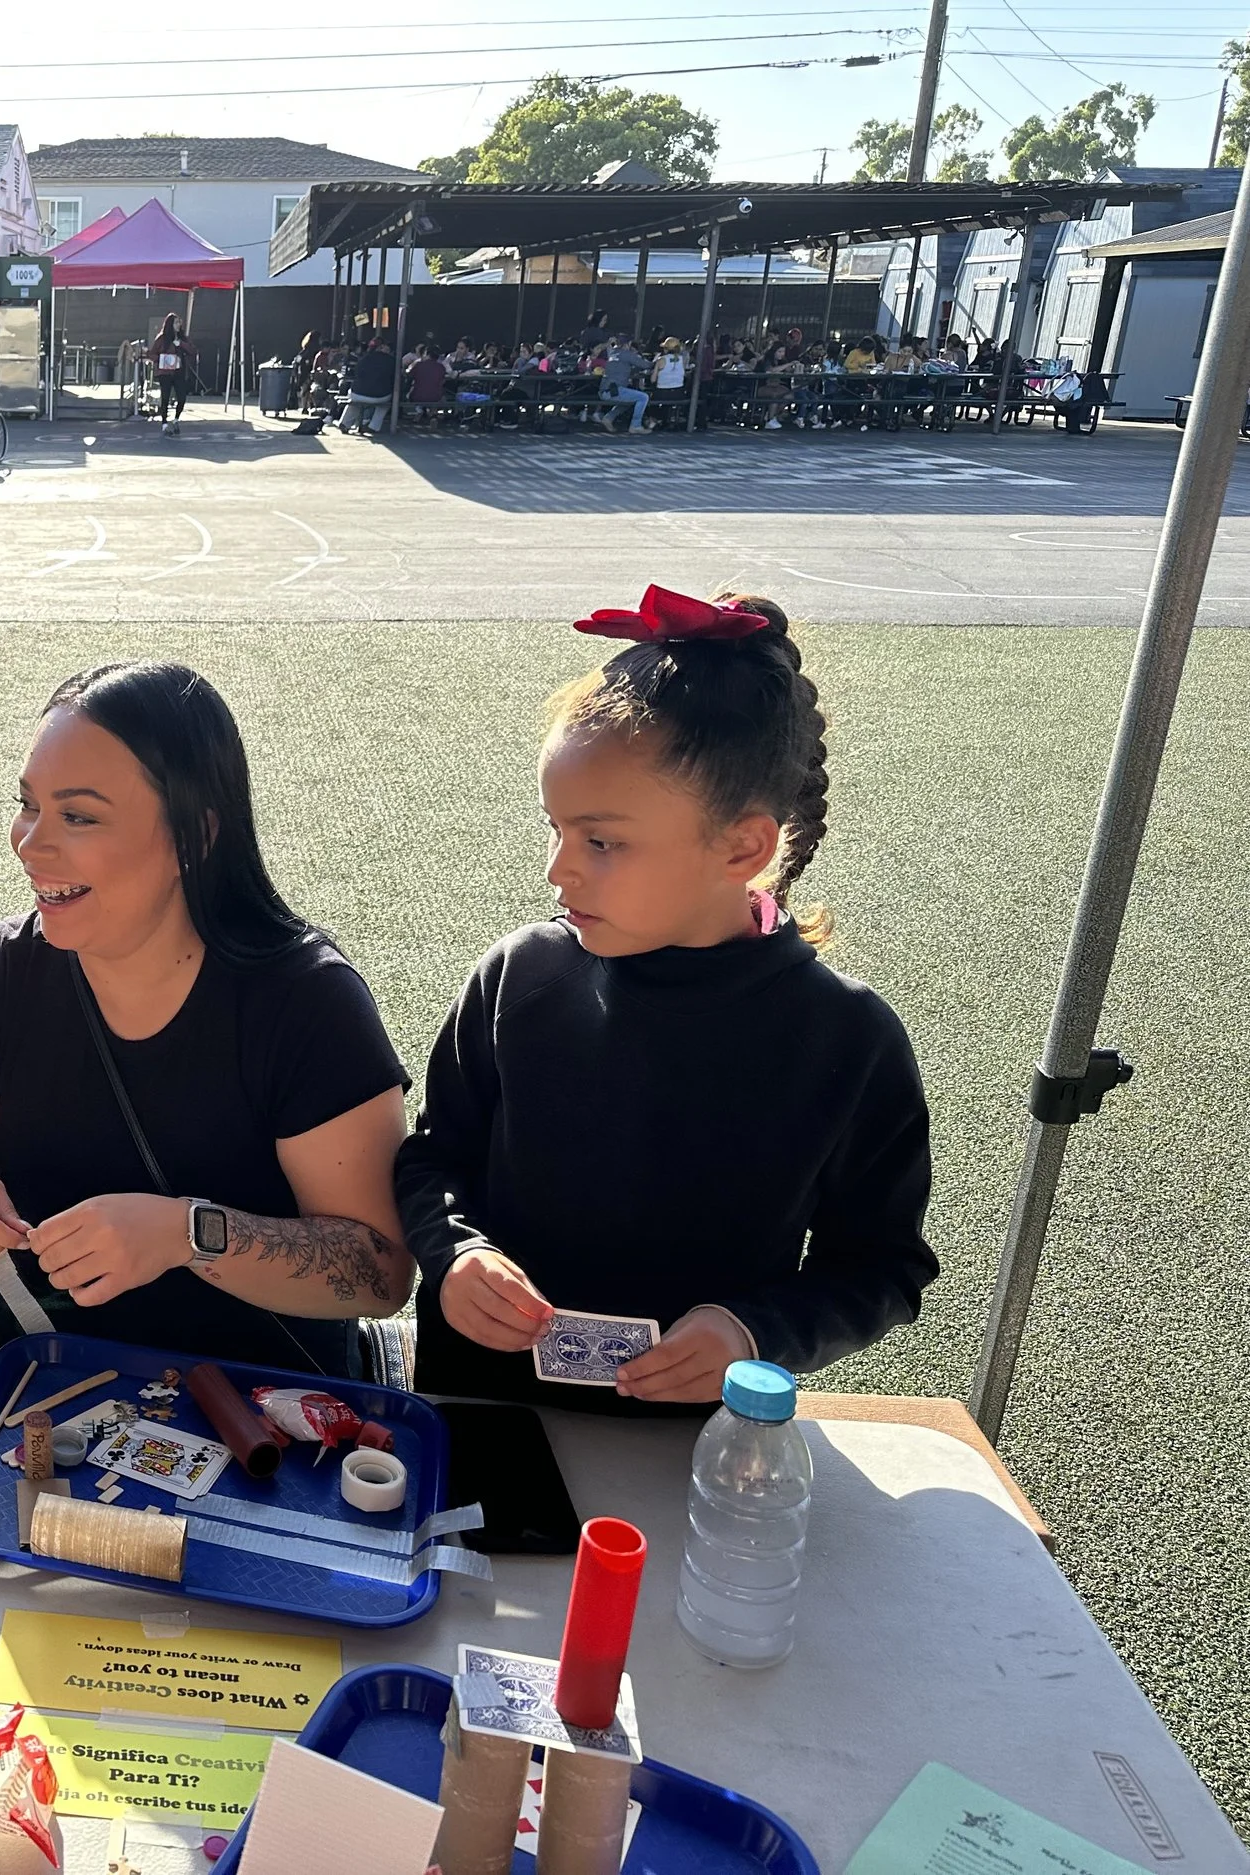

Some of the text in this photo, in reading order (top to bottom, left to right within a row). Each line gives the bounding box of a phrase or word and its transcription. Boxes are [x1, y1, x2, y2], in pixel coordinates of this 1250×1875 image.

[126, 1647, 162, 1657] ideas
[163, 1651, 198, 1660] your
[200, 1654, 239, 1664] write
[102, 1662, 240, 1683] mean to you?
[262, 1661, 302, 1672] Draw
[63, 1674, 287, 1710] What does Creativity
[71, 1744, 169, 1764] Significa
[174, 1753, 266, 1773] Creativi
[108, 1768, 201, 1788] Para Ti?
[85, 1791, 109, 1802] oh
[113, 1796, 181, 1809] escribe
[185, 1800, 216, 1812] tus
[220, 1802, 249, 1815] ide
